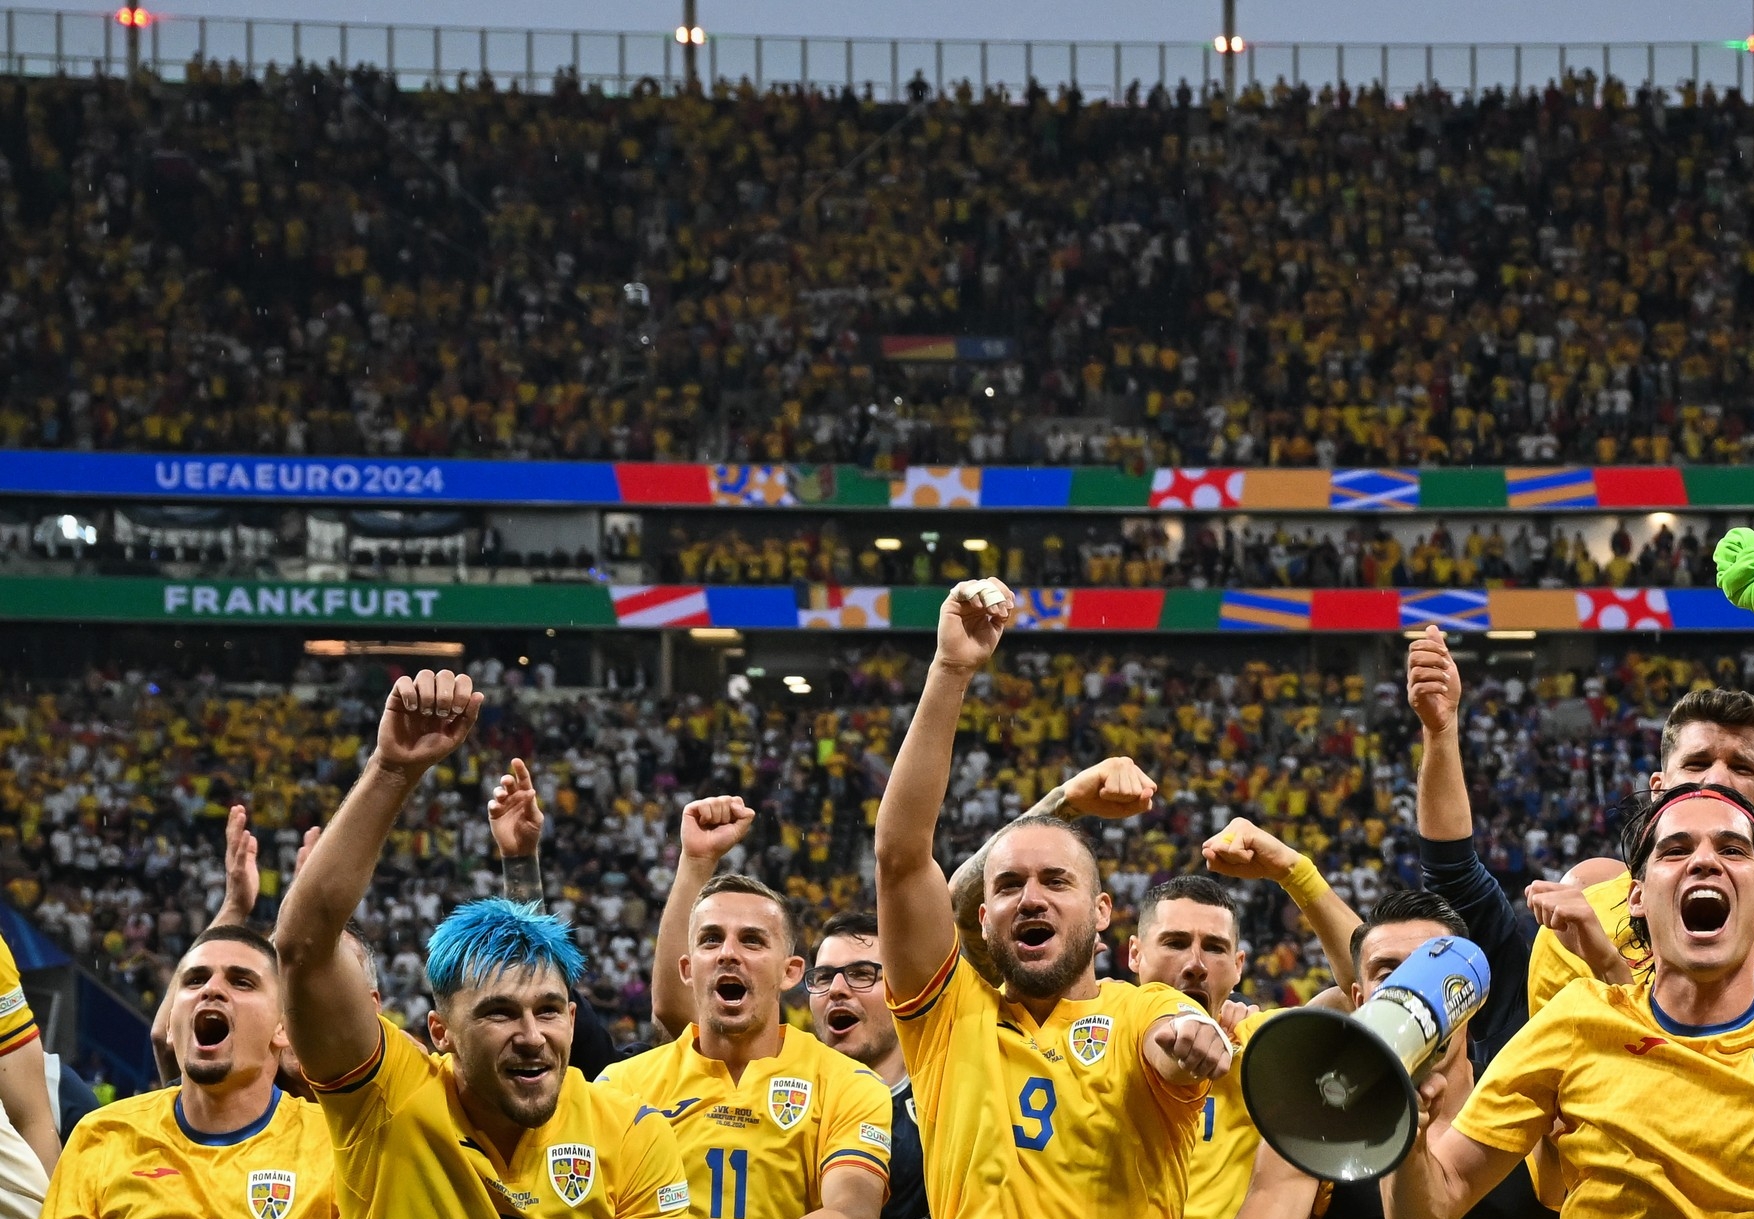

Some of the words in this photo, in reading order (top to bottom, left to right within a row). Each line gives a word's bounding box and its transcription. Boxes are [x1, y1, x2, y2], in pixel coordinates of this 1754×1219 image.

[163, 585, 440, 617] FRANKFURT
[773, 1079, 808, 1091] ROMÂNIA
[735, 1107, 752, 1117] ROU
[1012, 1077, 1057, 1151] 9
[552, 1145, 591, 1159] ROMÂNIA
[252, 1171, 291, 1182] ROMÂNIA
[705, 1148, 748, 1219] 11
